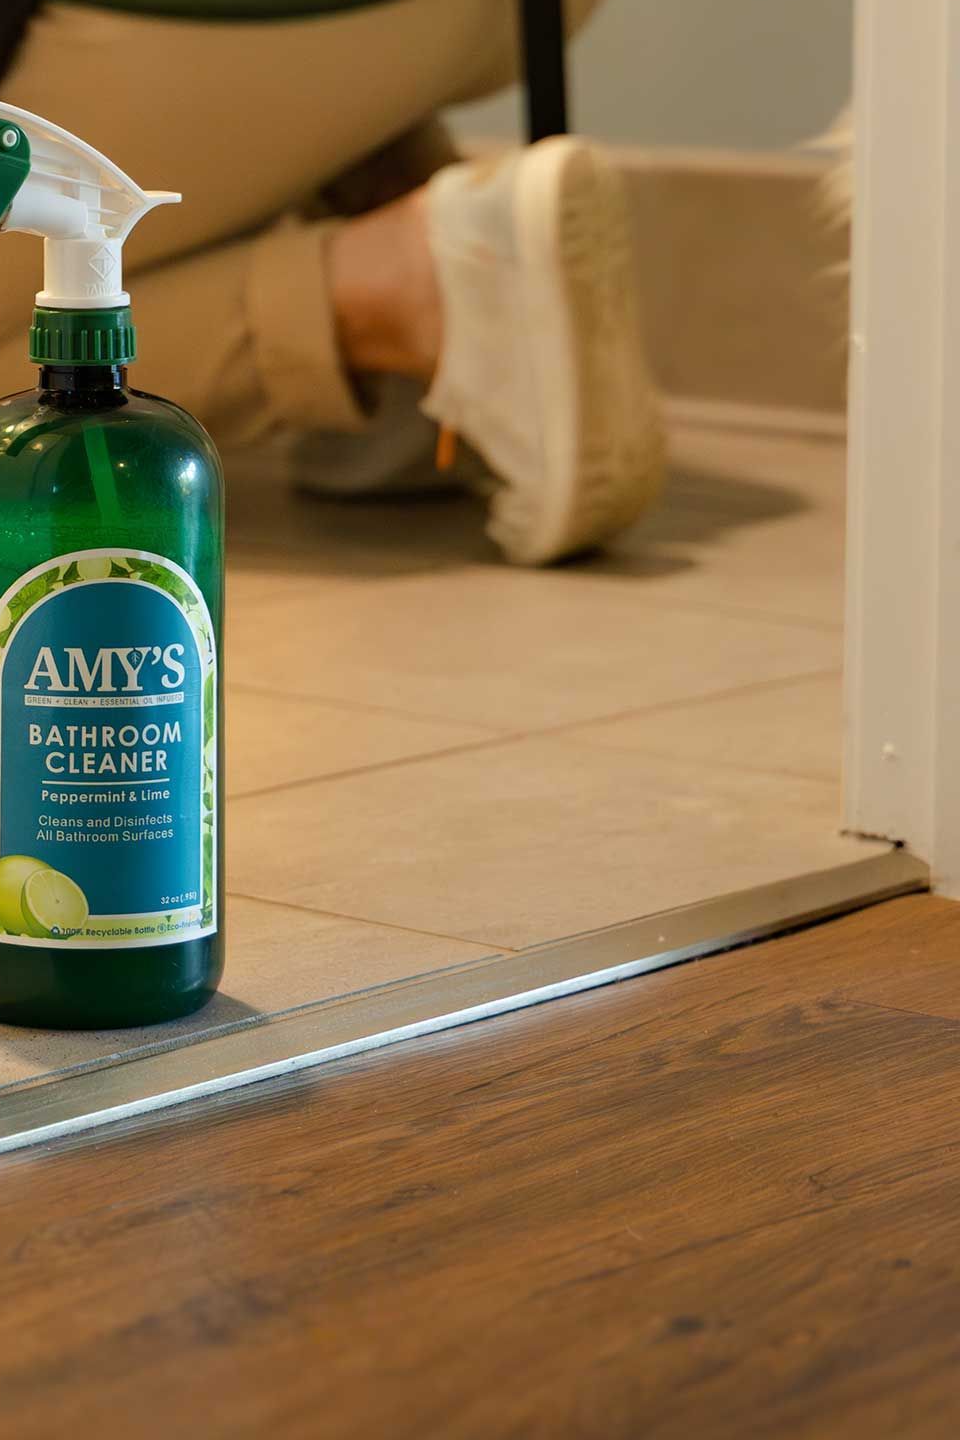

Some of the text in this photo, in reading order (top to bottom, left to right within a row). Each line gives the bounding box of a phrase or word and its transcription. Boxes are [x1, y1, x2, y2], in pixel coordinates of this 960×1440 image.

[24, 643, 185, 692] AMY'S
[26, 696, 52, 705] GREEN
[63, 697, 88, 706] CLEAN
[100, 697, 139, 706] ESSENTIAL
[143, 696, 153, 705] OIL
[29, 720, 182, 747] BATHROOM
[45, 750, 168, 774] CLEANER
[41, 789, 170, 805] Peppermint & Lime
[38, 813, 173, 828] Cleans and Disinfects
[36, 828, 174, 843] All Bathroom Surfaces
[160, 895, 170, 905] 32
[85, 927, 132, 938] Recyclable
